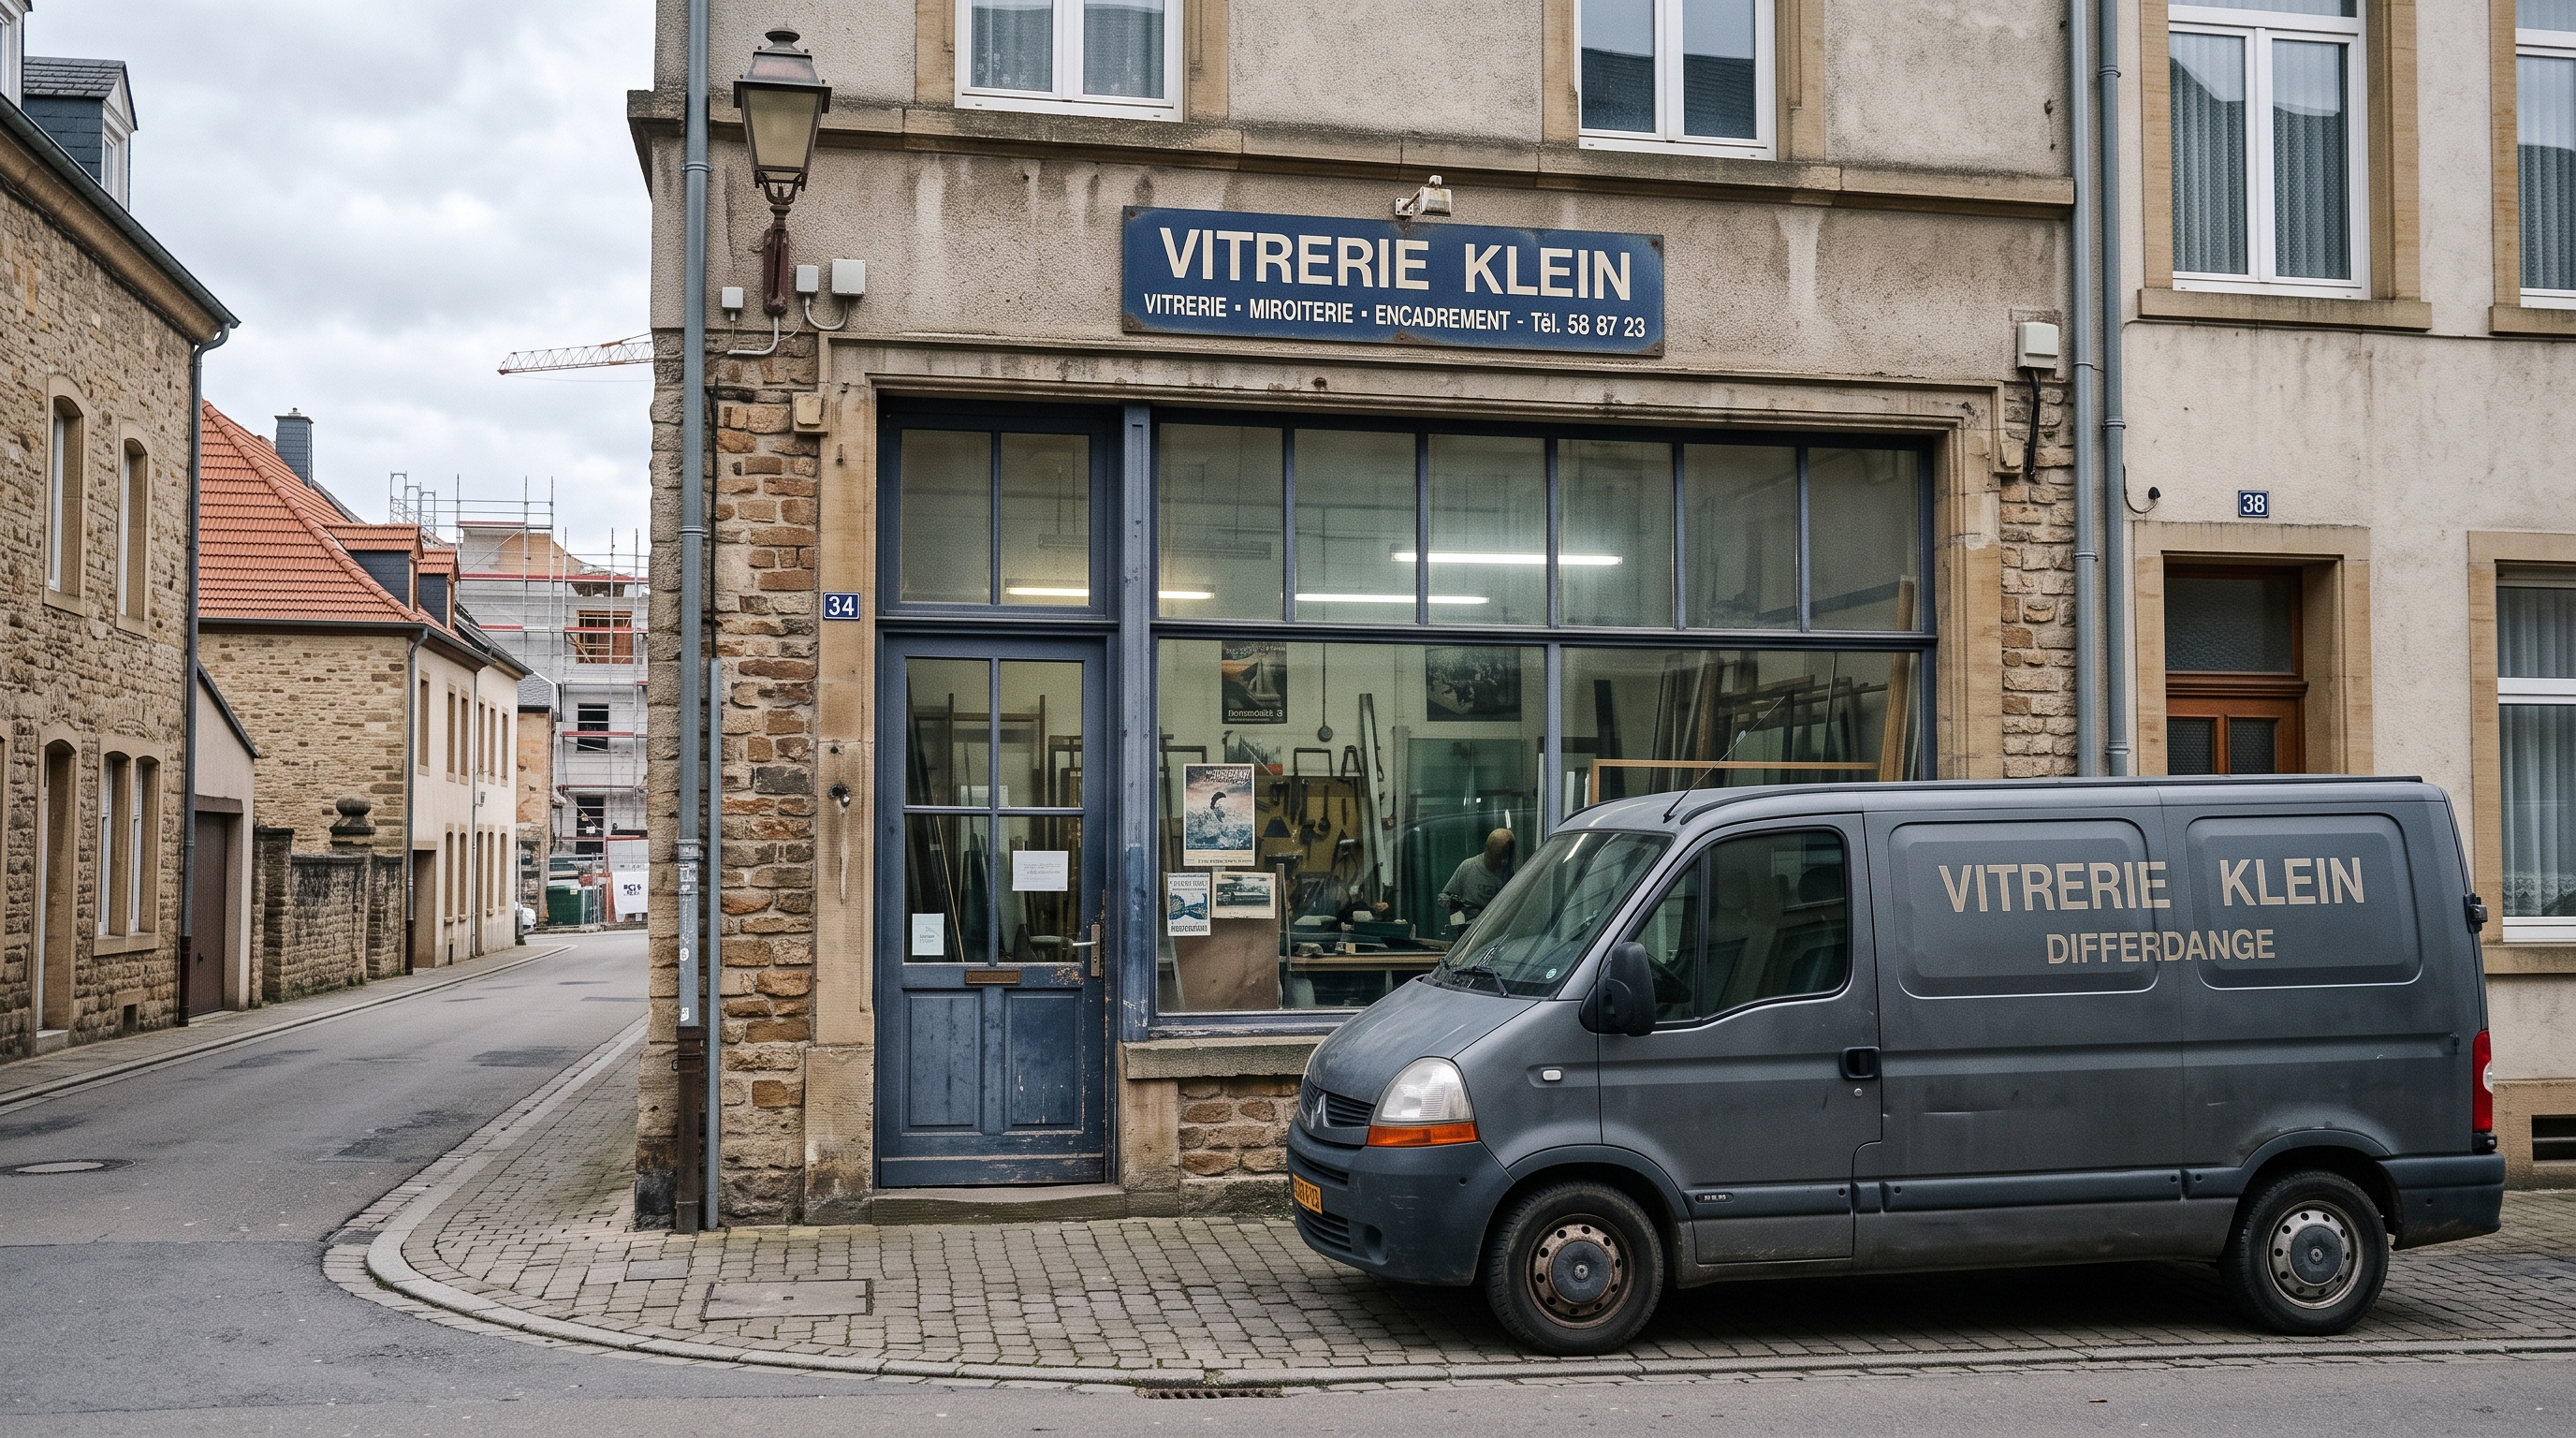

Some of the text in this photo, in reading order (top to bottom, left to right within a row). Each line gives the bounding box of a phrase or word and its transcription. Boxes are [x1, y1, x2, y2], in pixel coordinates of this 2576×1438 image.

[1159, 227, 1631, 301] VITRERIE KLEIN
[1144, 293, 1227, 317] VITRERIE
[1250, 298, 1354, 324] MIROITERIE
[1375, 304, 1511, 330] ENCADREMENT
[1567, 314, 1590, 335] 58
[1596, 315, 1617, 336] 87
[1623, 316, 1646, 338] 23
[2243, 493, 2265, 513] 38
[828, 595, 855, 616] 34
[1938, 857, 2365, 913] VITRERIE KLEIN
[2046, 929, 2276, 964] DIFFERDANGE
